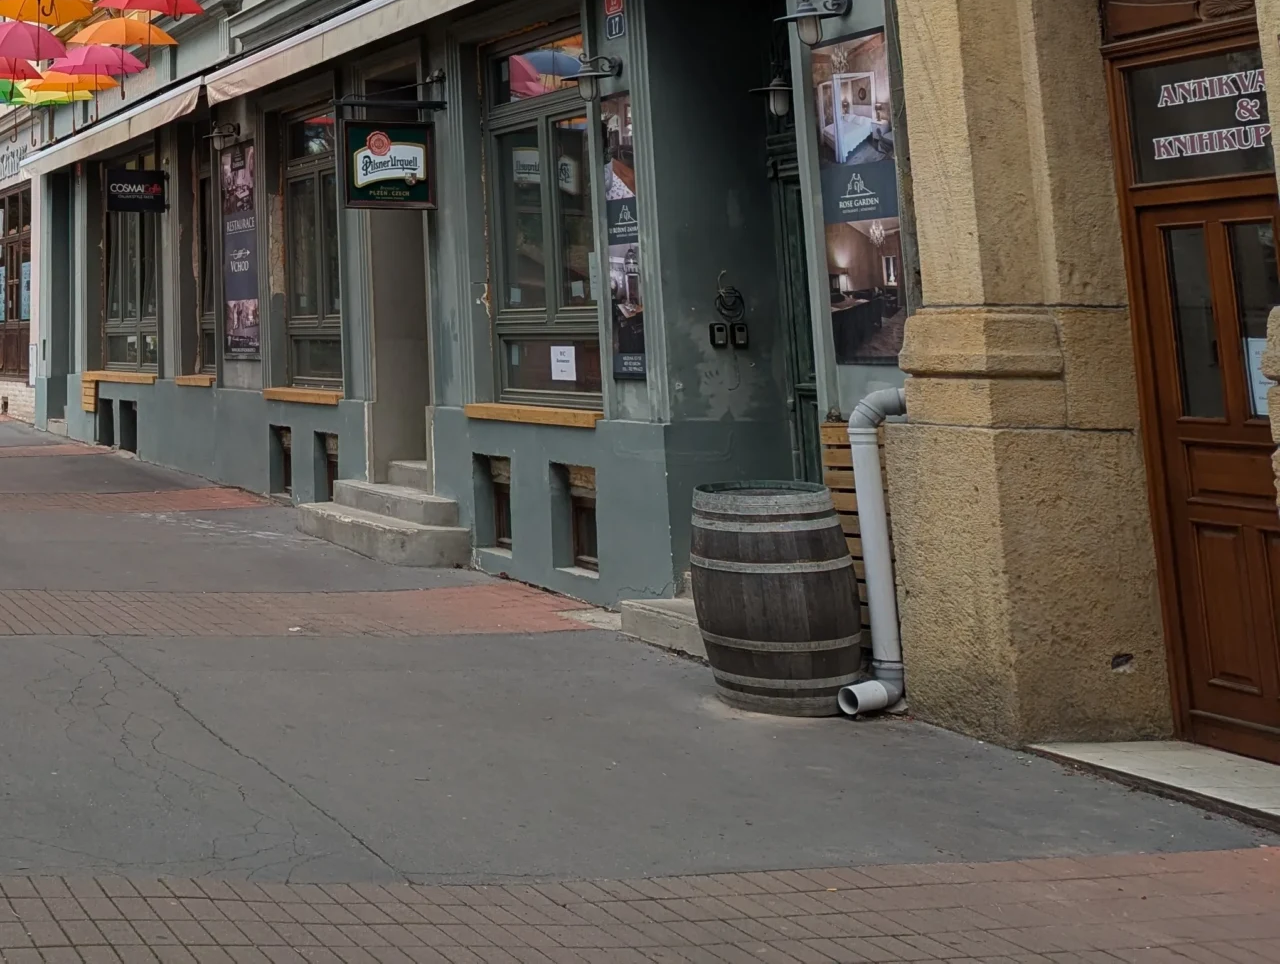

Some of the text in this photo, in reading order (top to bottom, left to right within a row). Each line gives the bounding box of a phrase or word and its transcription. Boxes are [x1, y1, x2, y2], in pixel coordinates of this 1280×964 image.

[611, 16, 620, 35] 17
[1235, 98, 1260, 121] &
[1153, 124, 1272, 160] KNIHKUP
[362, 155, 419, 176] Pilsner Urquell
[839, 197, 879, 208] ROSE GARDEN
[226, 217, 255, 233] RESTAURACE
[230, 260, 250, 273] VCHOD
